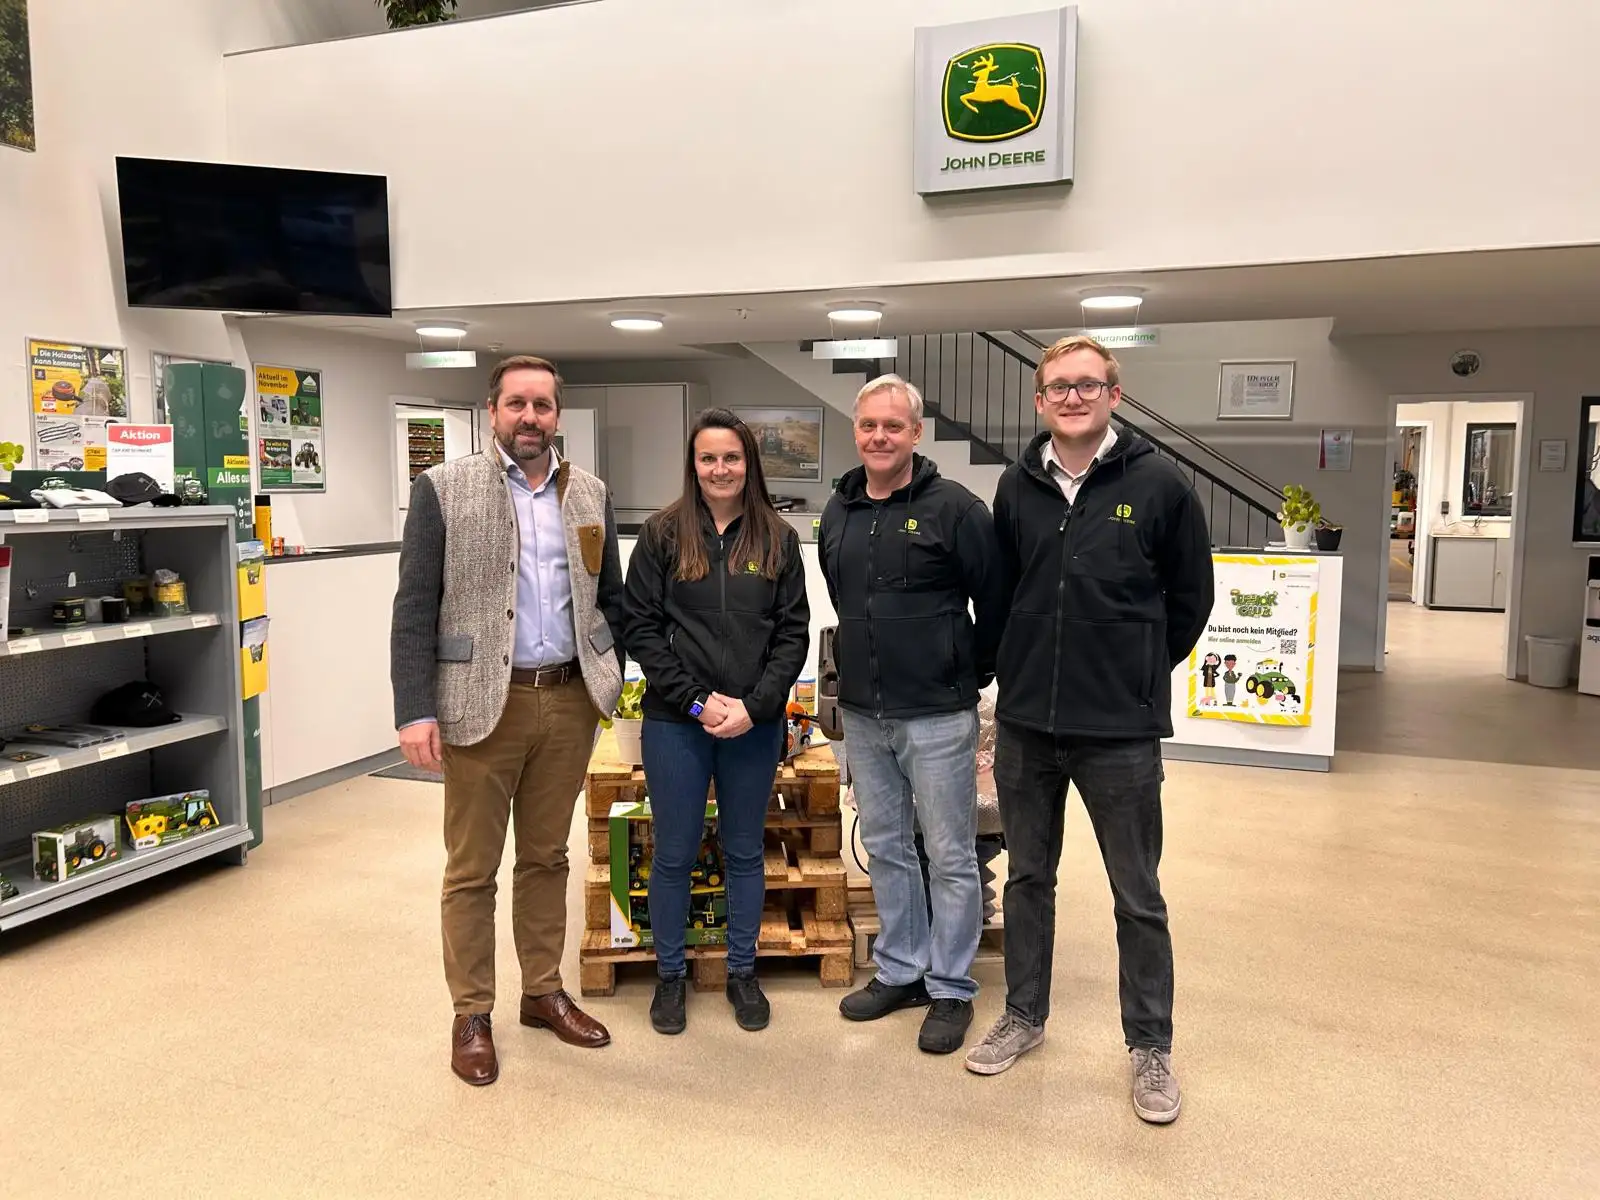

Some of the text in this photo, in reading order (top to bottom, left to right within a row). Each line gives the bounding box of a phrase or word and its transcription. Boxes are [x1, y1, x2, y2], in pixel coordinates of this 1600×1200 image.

[940, 150, 1045, 171] JOHN DEERE
[258, 372, 280, 381] Aktuell
[258, 380, 288, 389] November
[120, 430, 161, 440] Aktion
[216, 471, 240, 484] Alles
[1208, 624, 1298, 638] Du bist noch kein Mitglied?
